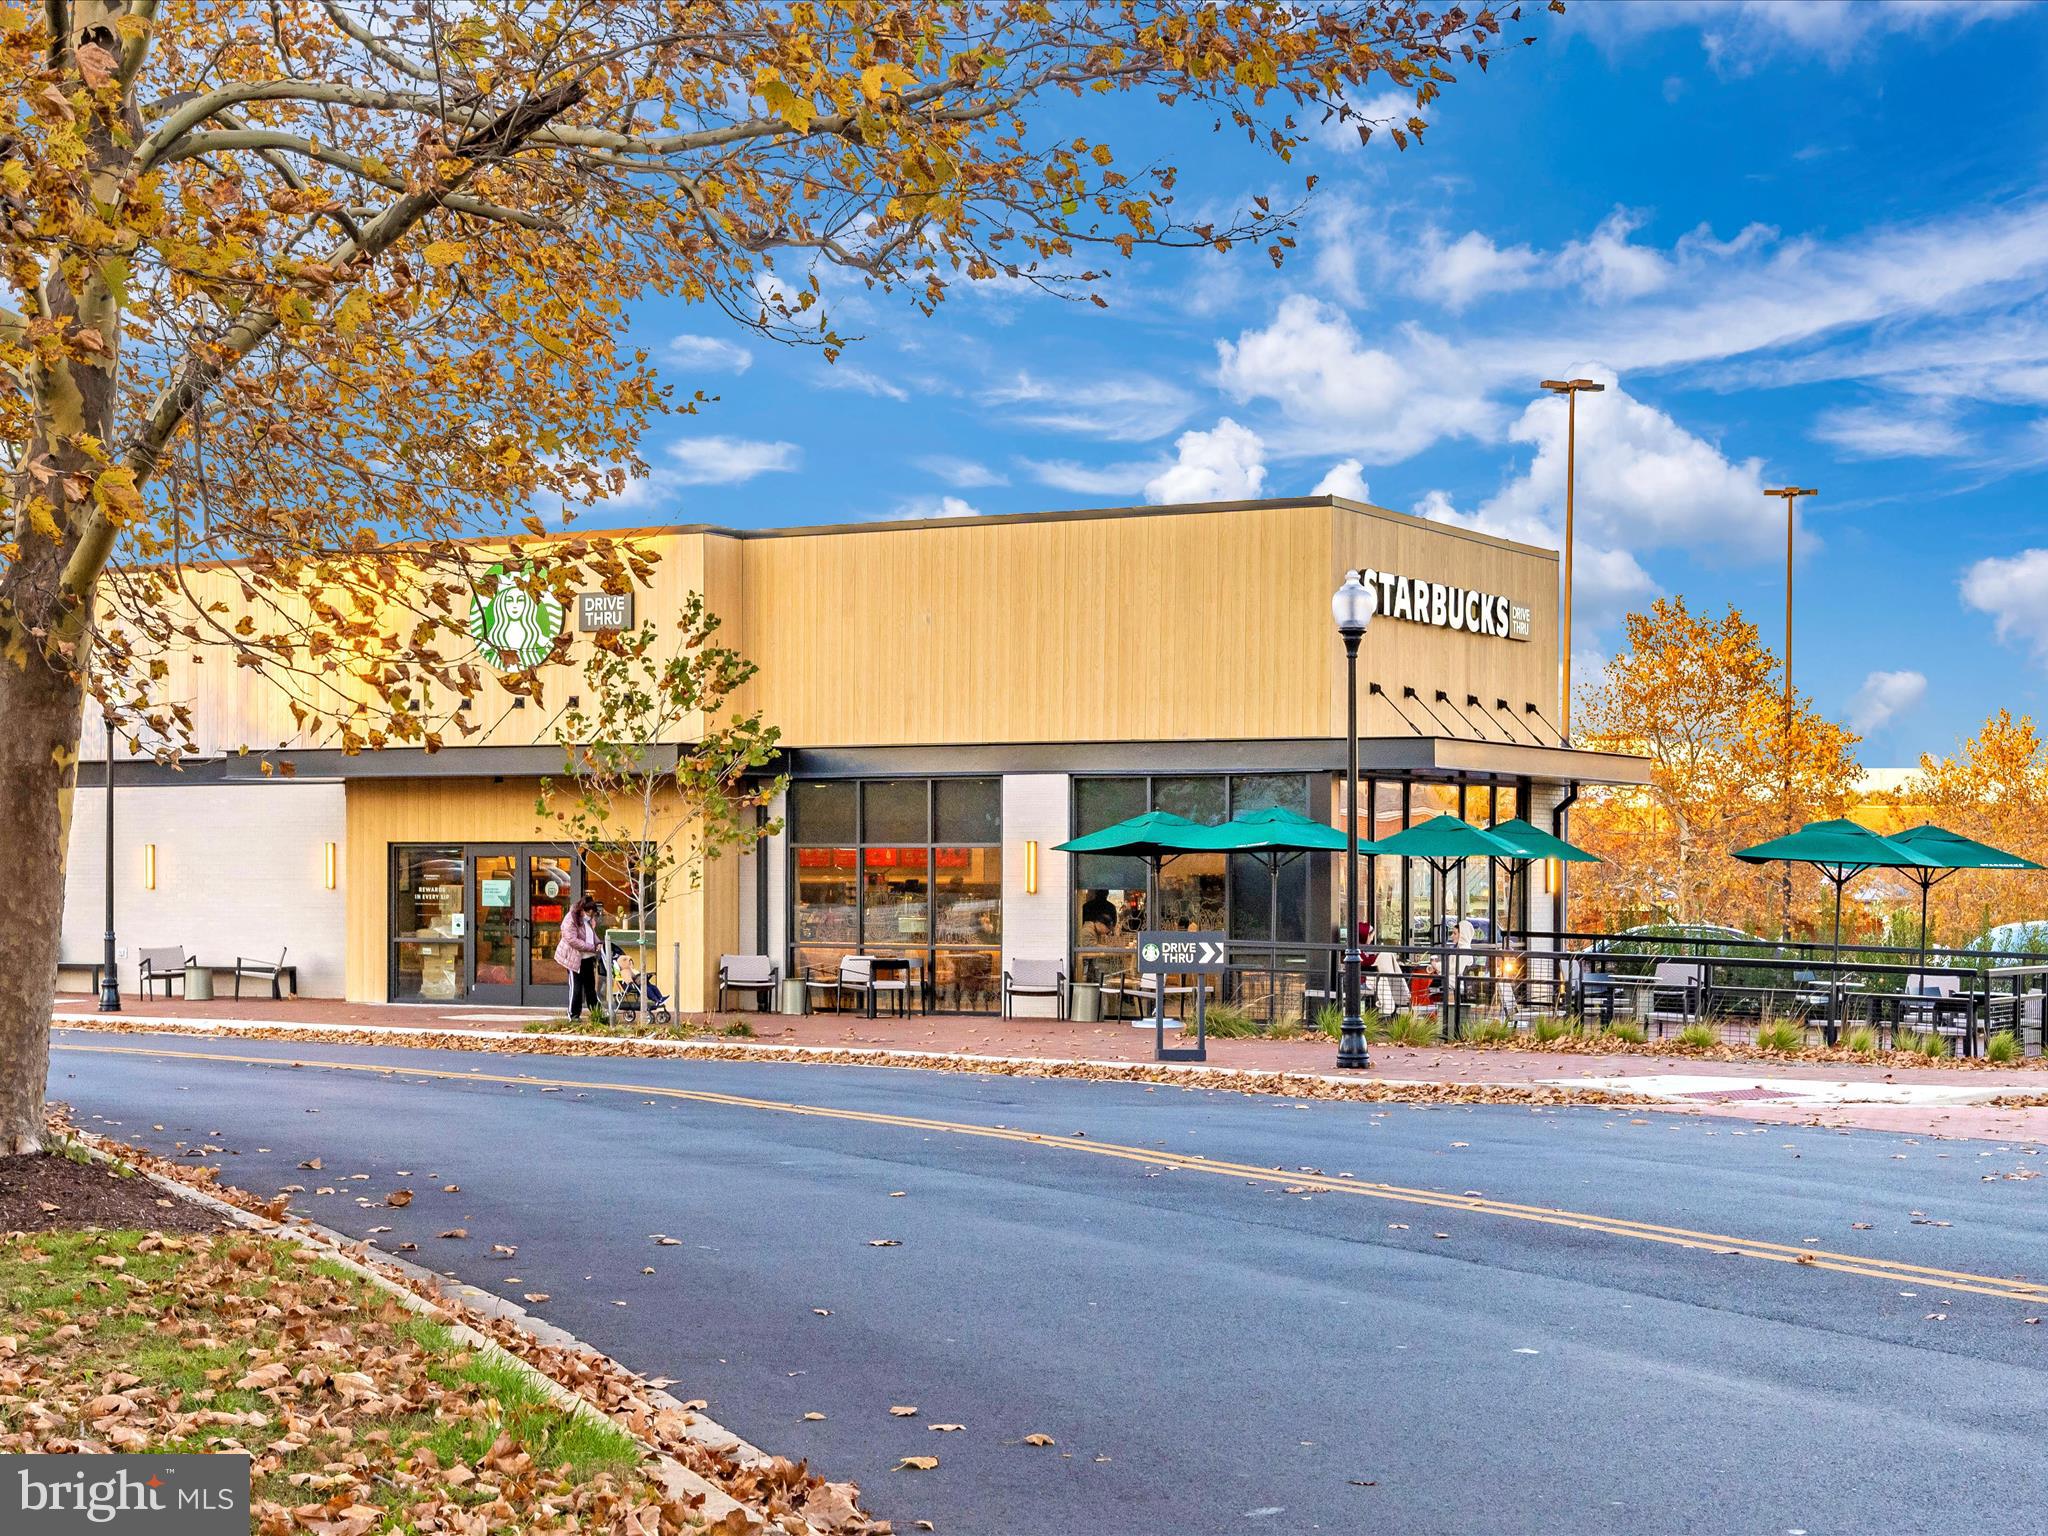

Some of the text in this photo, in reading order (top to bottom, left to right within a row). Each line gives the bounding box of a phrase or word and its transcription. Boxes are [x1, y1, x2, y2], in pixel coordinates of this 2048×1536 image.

[585, 597, 625, 611] DRIVE
[585, 611, 622, 625] THRU
[1512, 607, 1530, 622] DRIVE
[1512, 620, 1530, 636] THRU
[1162, 942, 1197, 953] DRIVE
[1162, 953, 1194, 964] THRU
